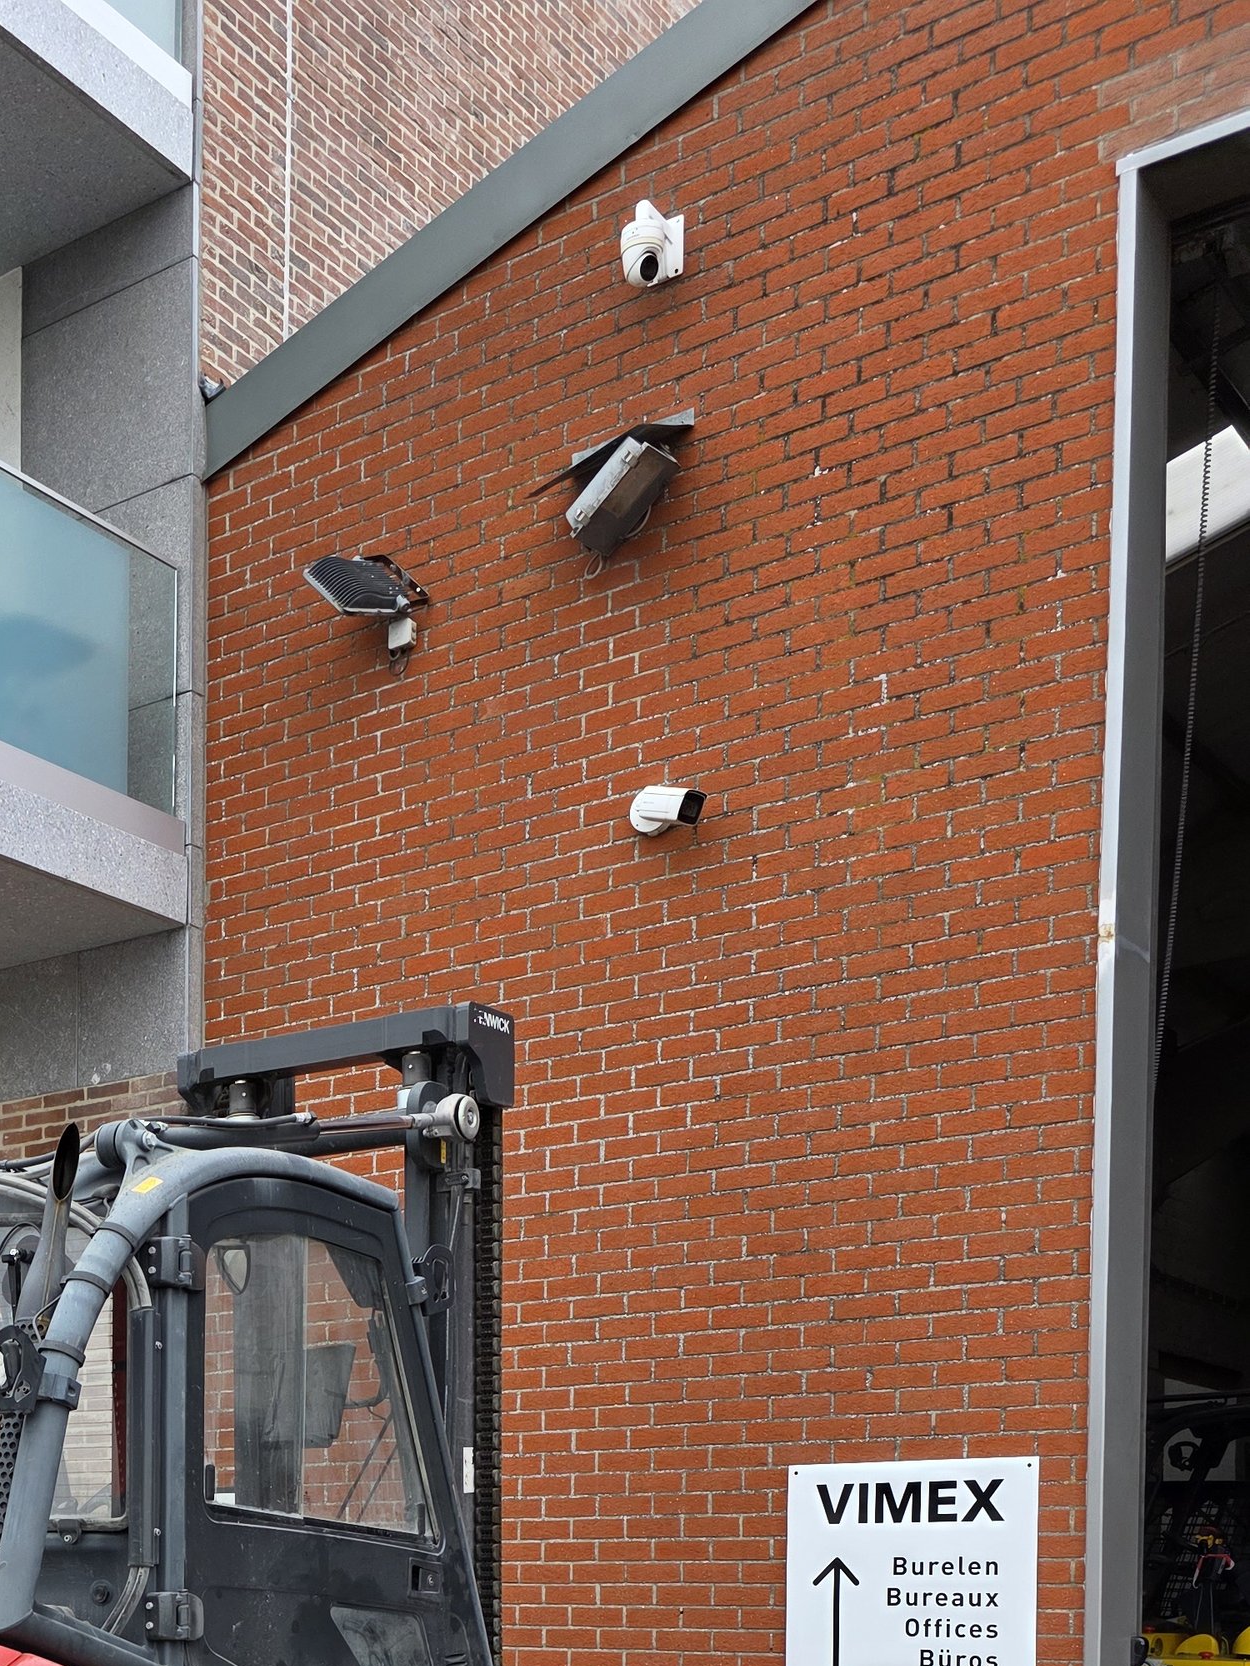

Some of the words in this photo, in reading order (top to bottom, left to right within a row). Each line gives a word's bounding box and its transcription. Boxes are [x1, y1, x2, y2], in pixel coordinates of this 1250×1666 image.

[473, 1006, 510, 1035] NWICK
[816, 1478, 1005, 1525] VIMEX
[892, 1556, 999, 1576] Burelen
[886, 1587, 999, 1608] Bureaux
[904, 1618, 999, 1639] Offices
